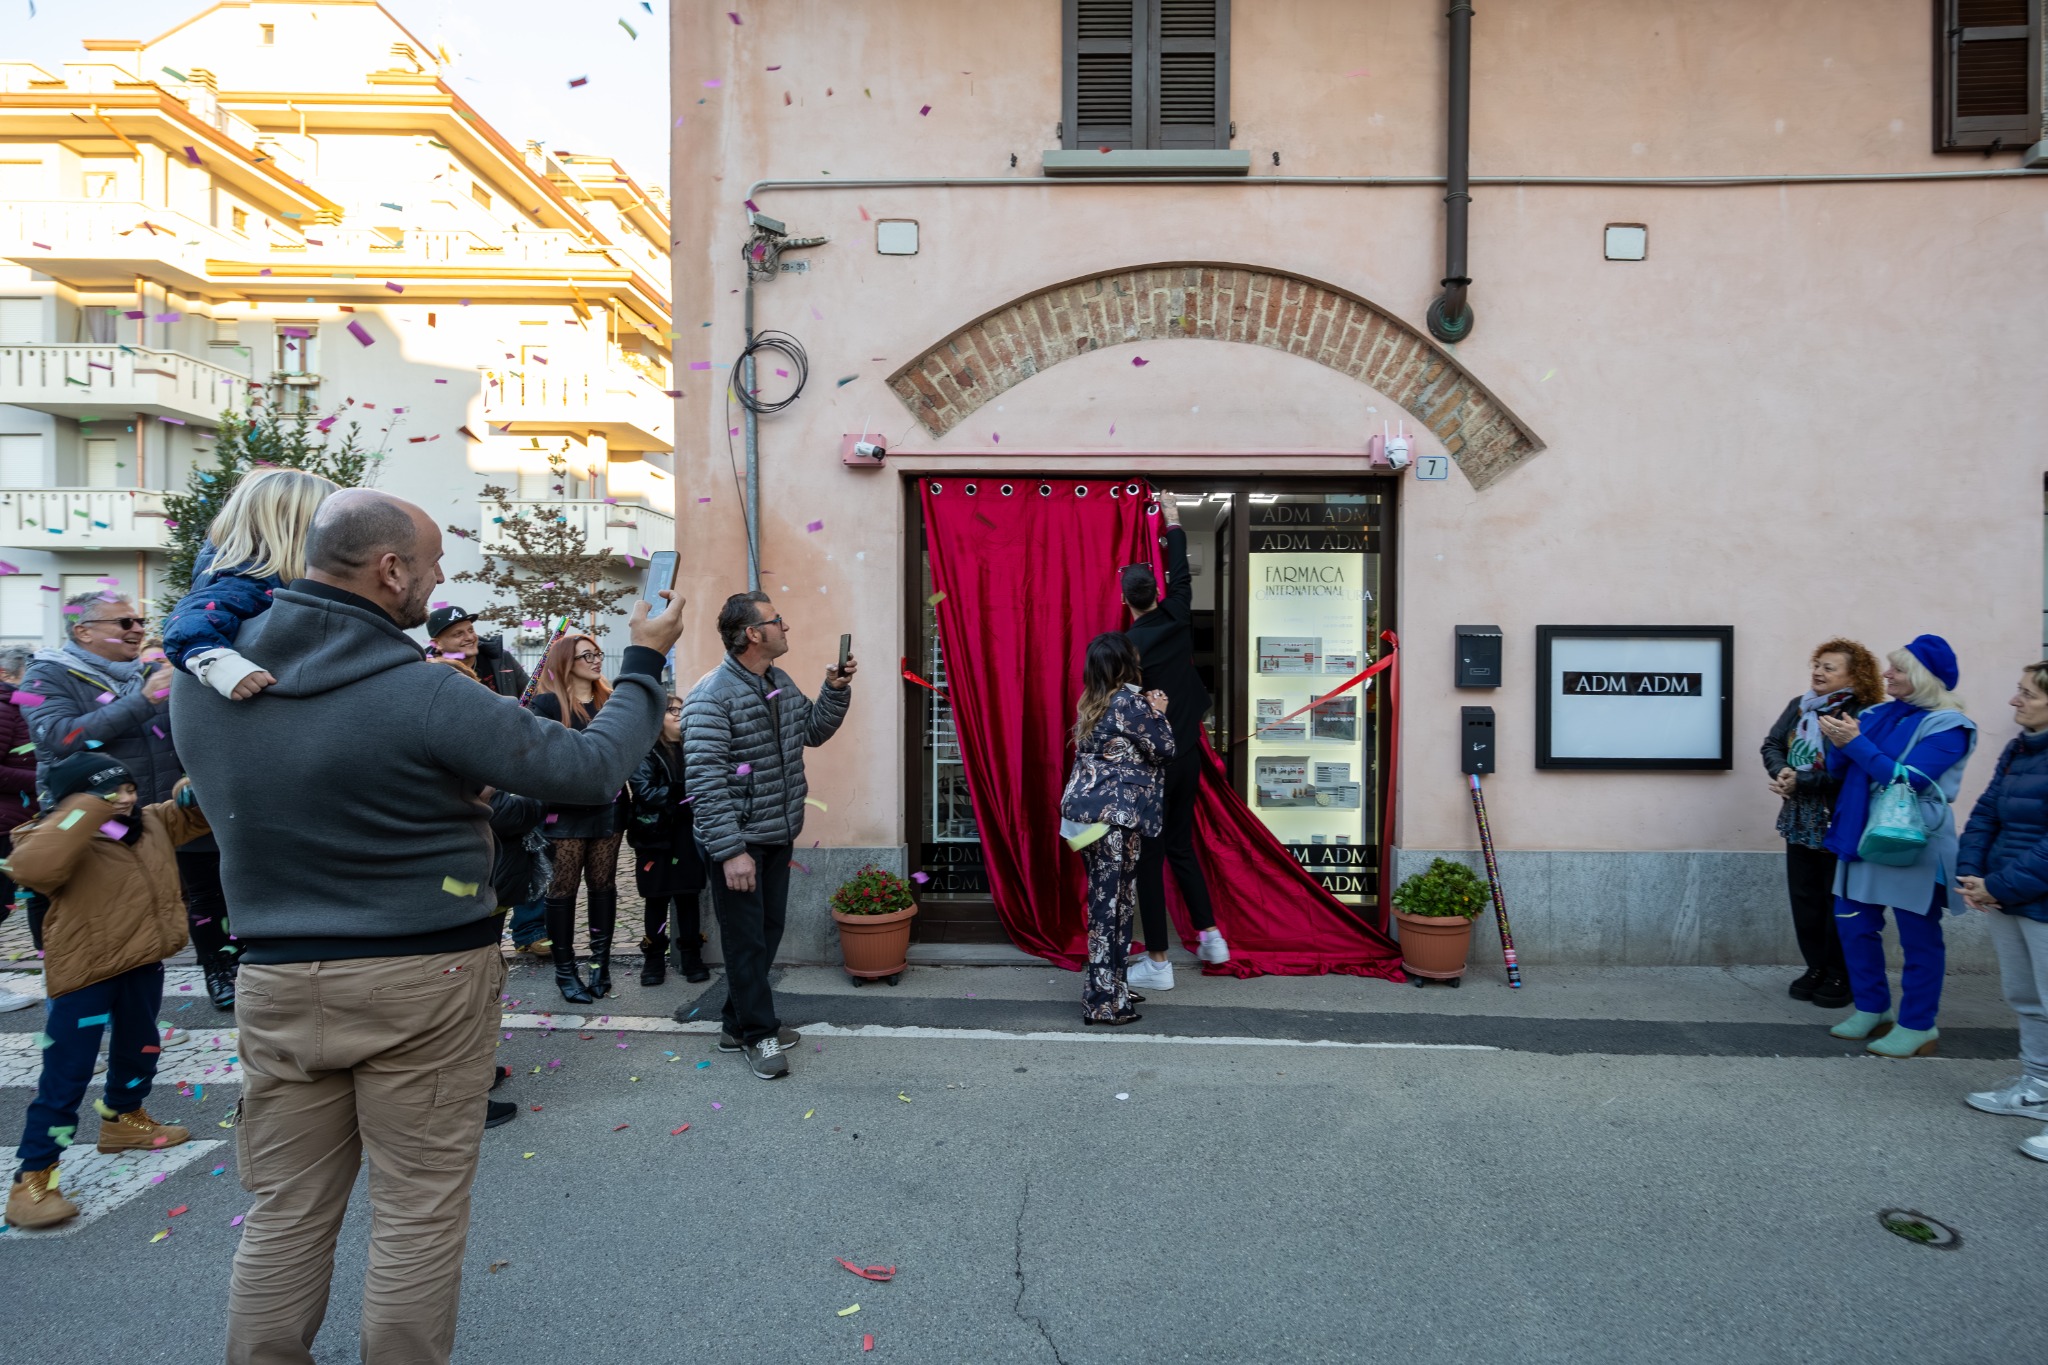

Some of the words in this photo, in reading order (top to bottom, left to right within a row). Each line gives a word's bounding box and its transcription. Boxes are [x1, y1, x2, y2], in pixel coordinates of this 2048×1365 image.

[1428, 459, 1436, 476] 7
[1262, 506, 1311, 523] ADM
[1322, 506, 1370, 523] ADM
[1260, 533, 1311, 550] ADM
[1320, 533, 1370, 550] ADM
[1265, 566, 1345, 583] FARMACA
[1265, 584, 1344, 597] INTERNATIONAL
[1574, 675, 1628, 692] ADM
[1637, 676, 1690, 693] ADM
[932, 846, 980, 863] ADM
[1320, 847, 1369, 864] ADM
[931, 874, 980, 890] ADM
[1322, 875, 1369, 892] ADM
